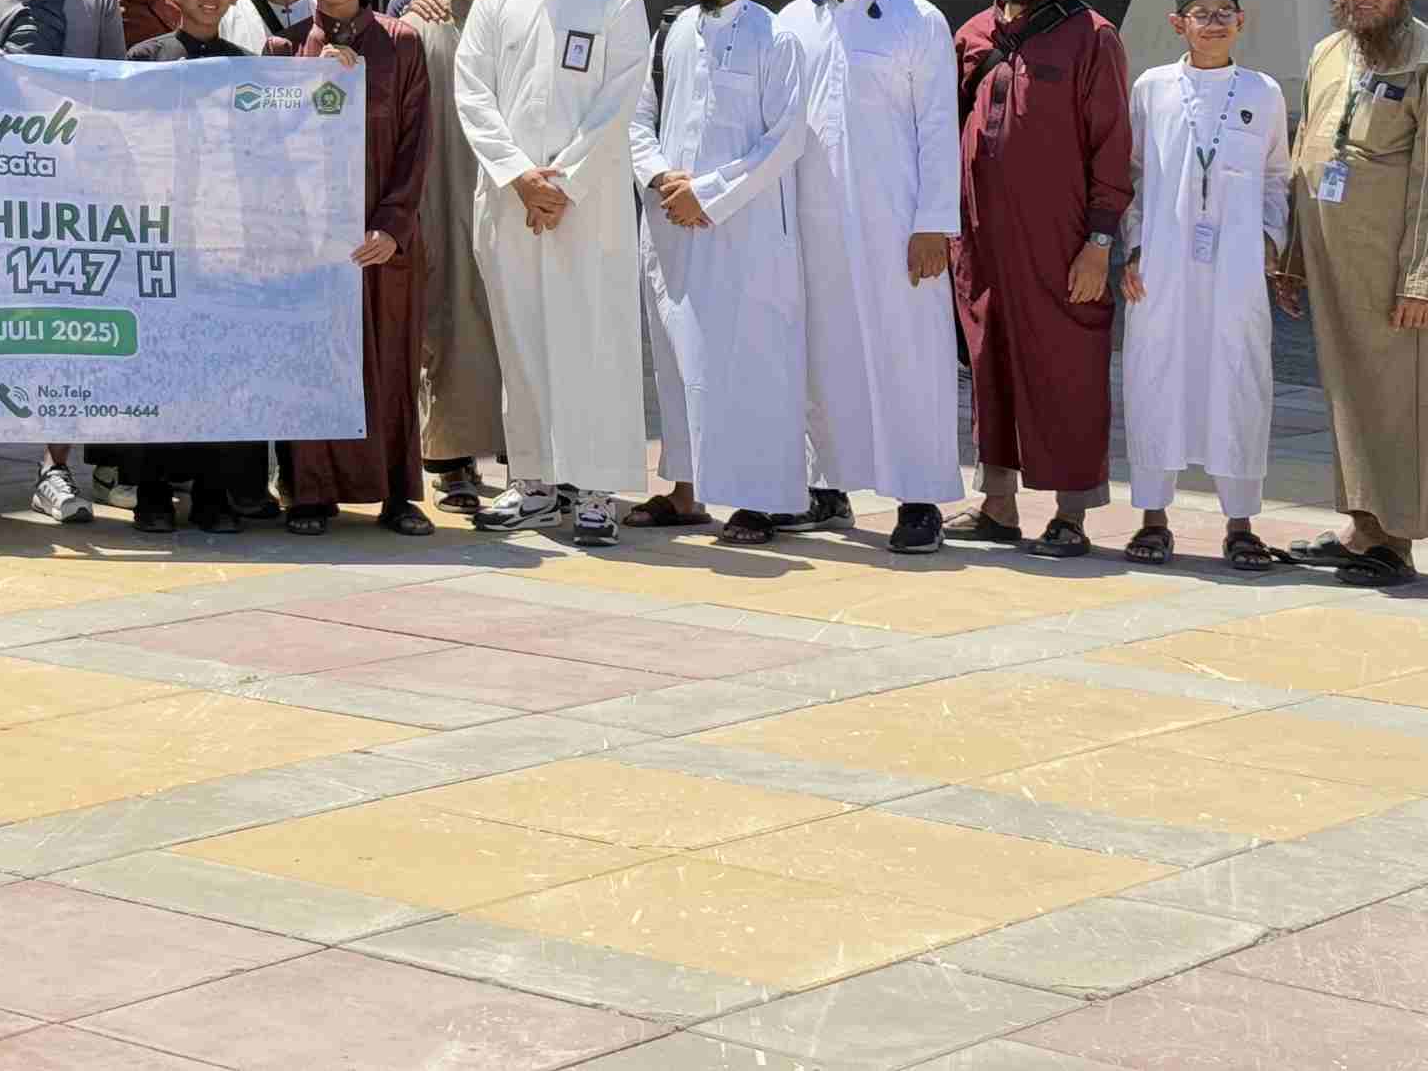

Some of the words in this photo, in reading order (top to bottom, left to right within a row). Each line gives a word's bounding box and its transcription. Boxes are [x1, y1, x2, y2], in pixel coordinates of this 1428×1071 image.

[262, 99, 301, 109] PATUH
[7, 246, 121, 296] 1447
[136, 250, 176, 298] H
[51, 321, 120, 347] 2025)
[38, 385, 92, 401] No.Telp
[38, 404, 160, 419] 0822-1000-4644
